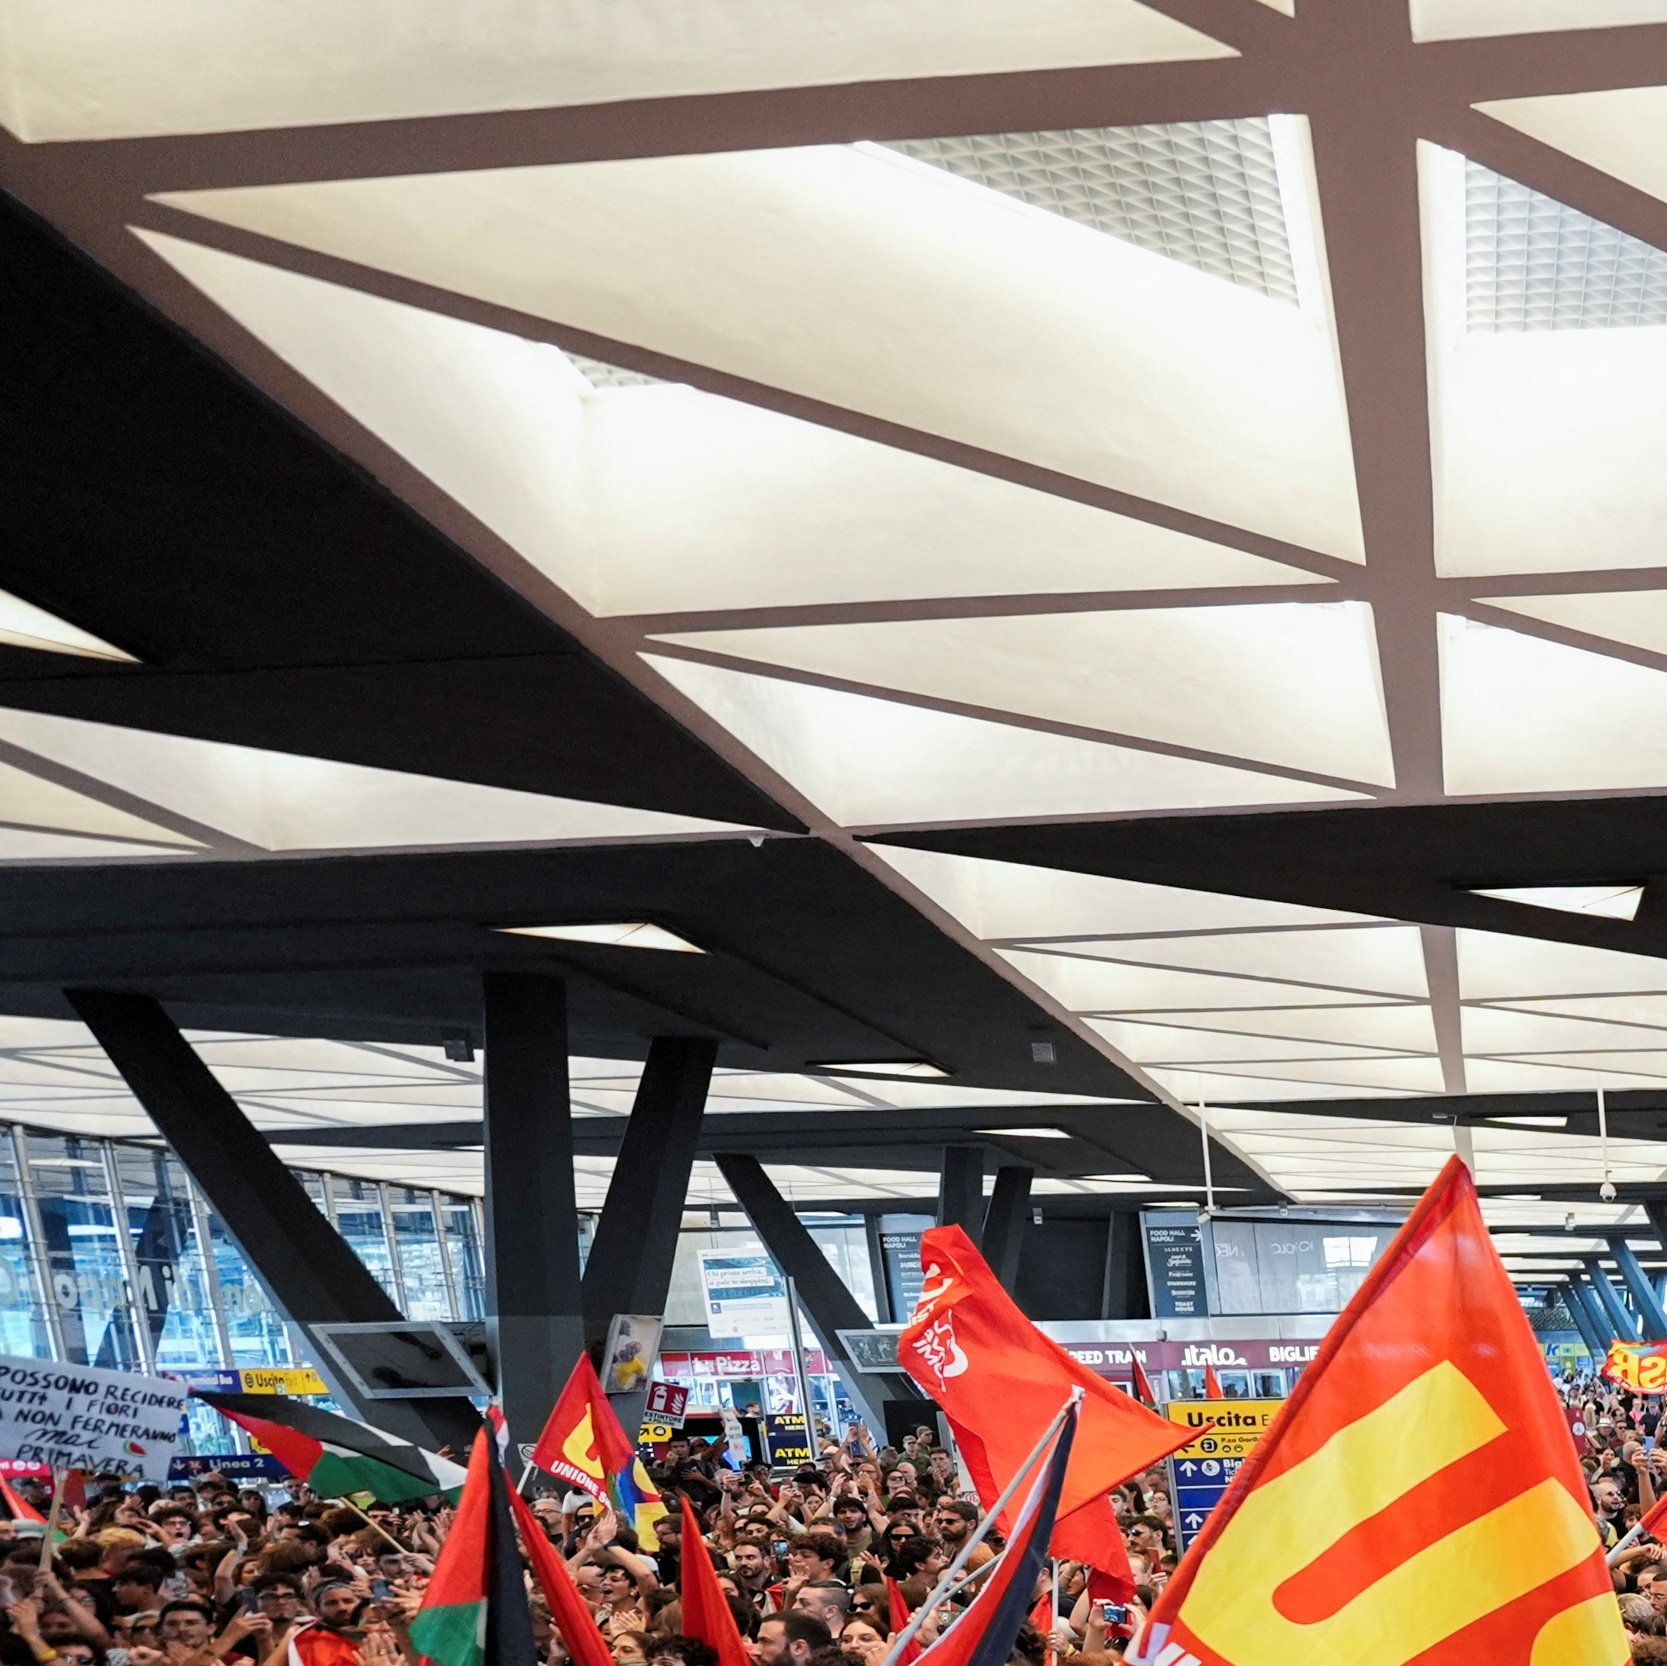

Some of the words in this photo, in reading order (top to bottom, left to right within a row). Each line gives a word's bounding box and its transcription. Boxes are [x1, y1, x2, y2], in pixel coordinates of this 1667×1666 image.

[716, 1356, 761, 1372] Pizza
[219, 1374, 233, 1387] Bus
[104, 1384, 186, 1411] RECIDERE
[87, 1399, 140, 1419] FIORI
[644, 1411, 683, 1424] ESTINTORE
[775, 1415, 805, 1425] ATM
[1187, 1411, 1257, 1428] Uscita
[14, 1409, 62, 1427] NON
[70, 1415, 177, 1444] FERMERANNO
[775, 1448, 810, 1458] ATM
[16, 1444, 145, 1479] PRIMAVERA
[209, 1458, 250, 1470] Linea
[255, 1457, 265, 1467] 2
[550, 1460, 599, 1494] UNIONE
